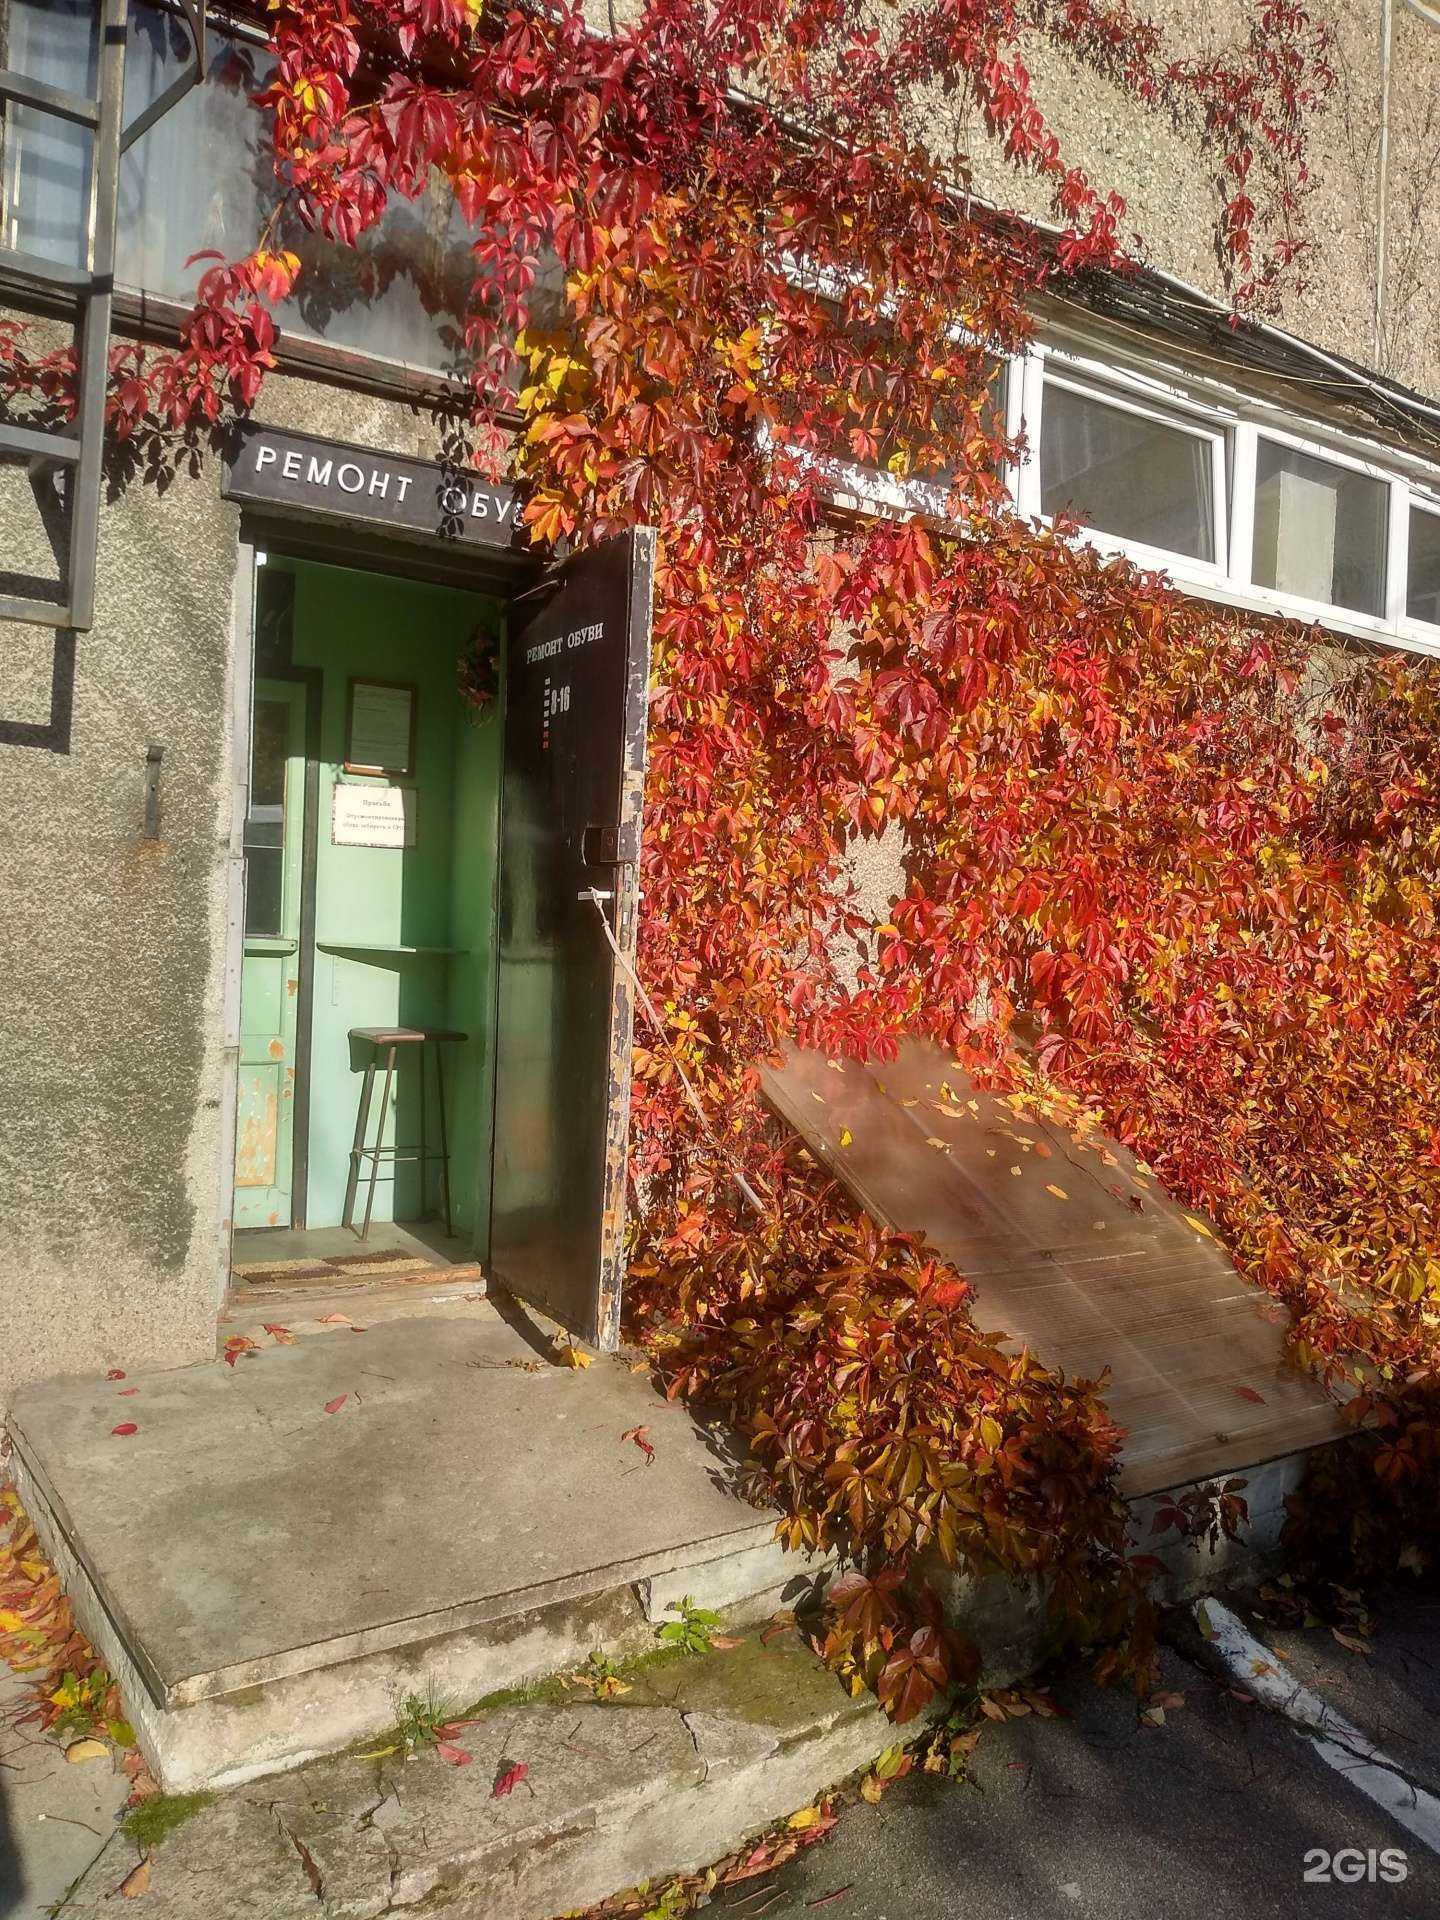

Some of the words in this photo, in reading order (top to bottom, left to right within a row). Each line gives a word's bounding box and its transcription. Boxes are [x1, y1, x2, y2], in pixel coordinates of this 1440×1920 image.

[255, 446, 413, 502] РЕМОНТ
[526, 637, 564, 664] РЕМОНТ
[567, 623, 604, 649] ОБУВИ
[550, 685, 571, 715] 8-16
